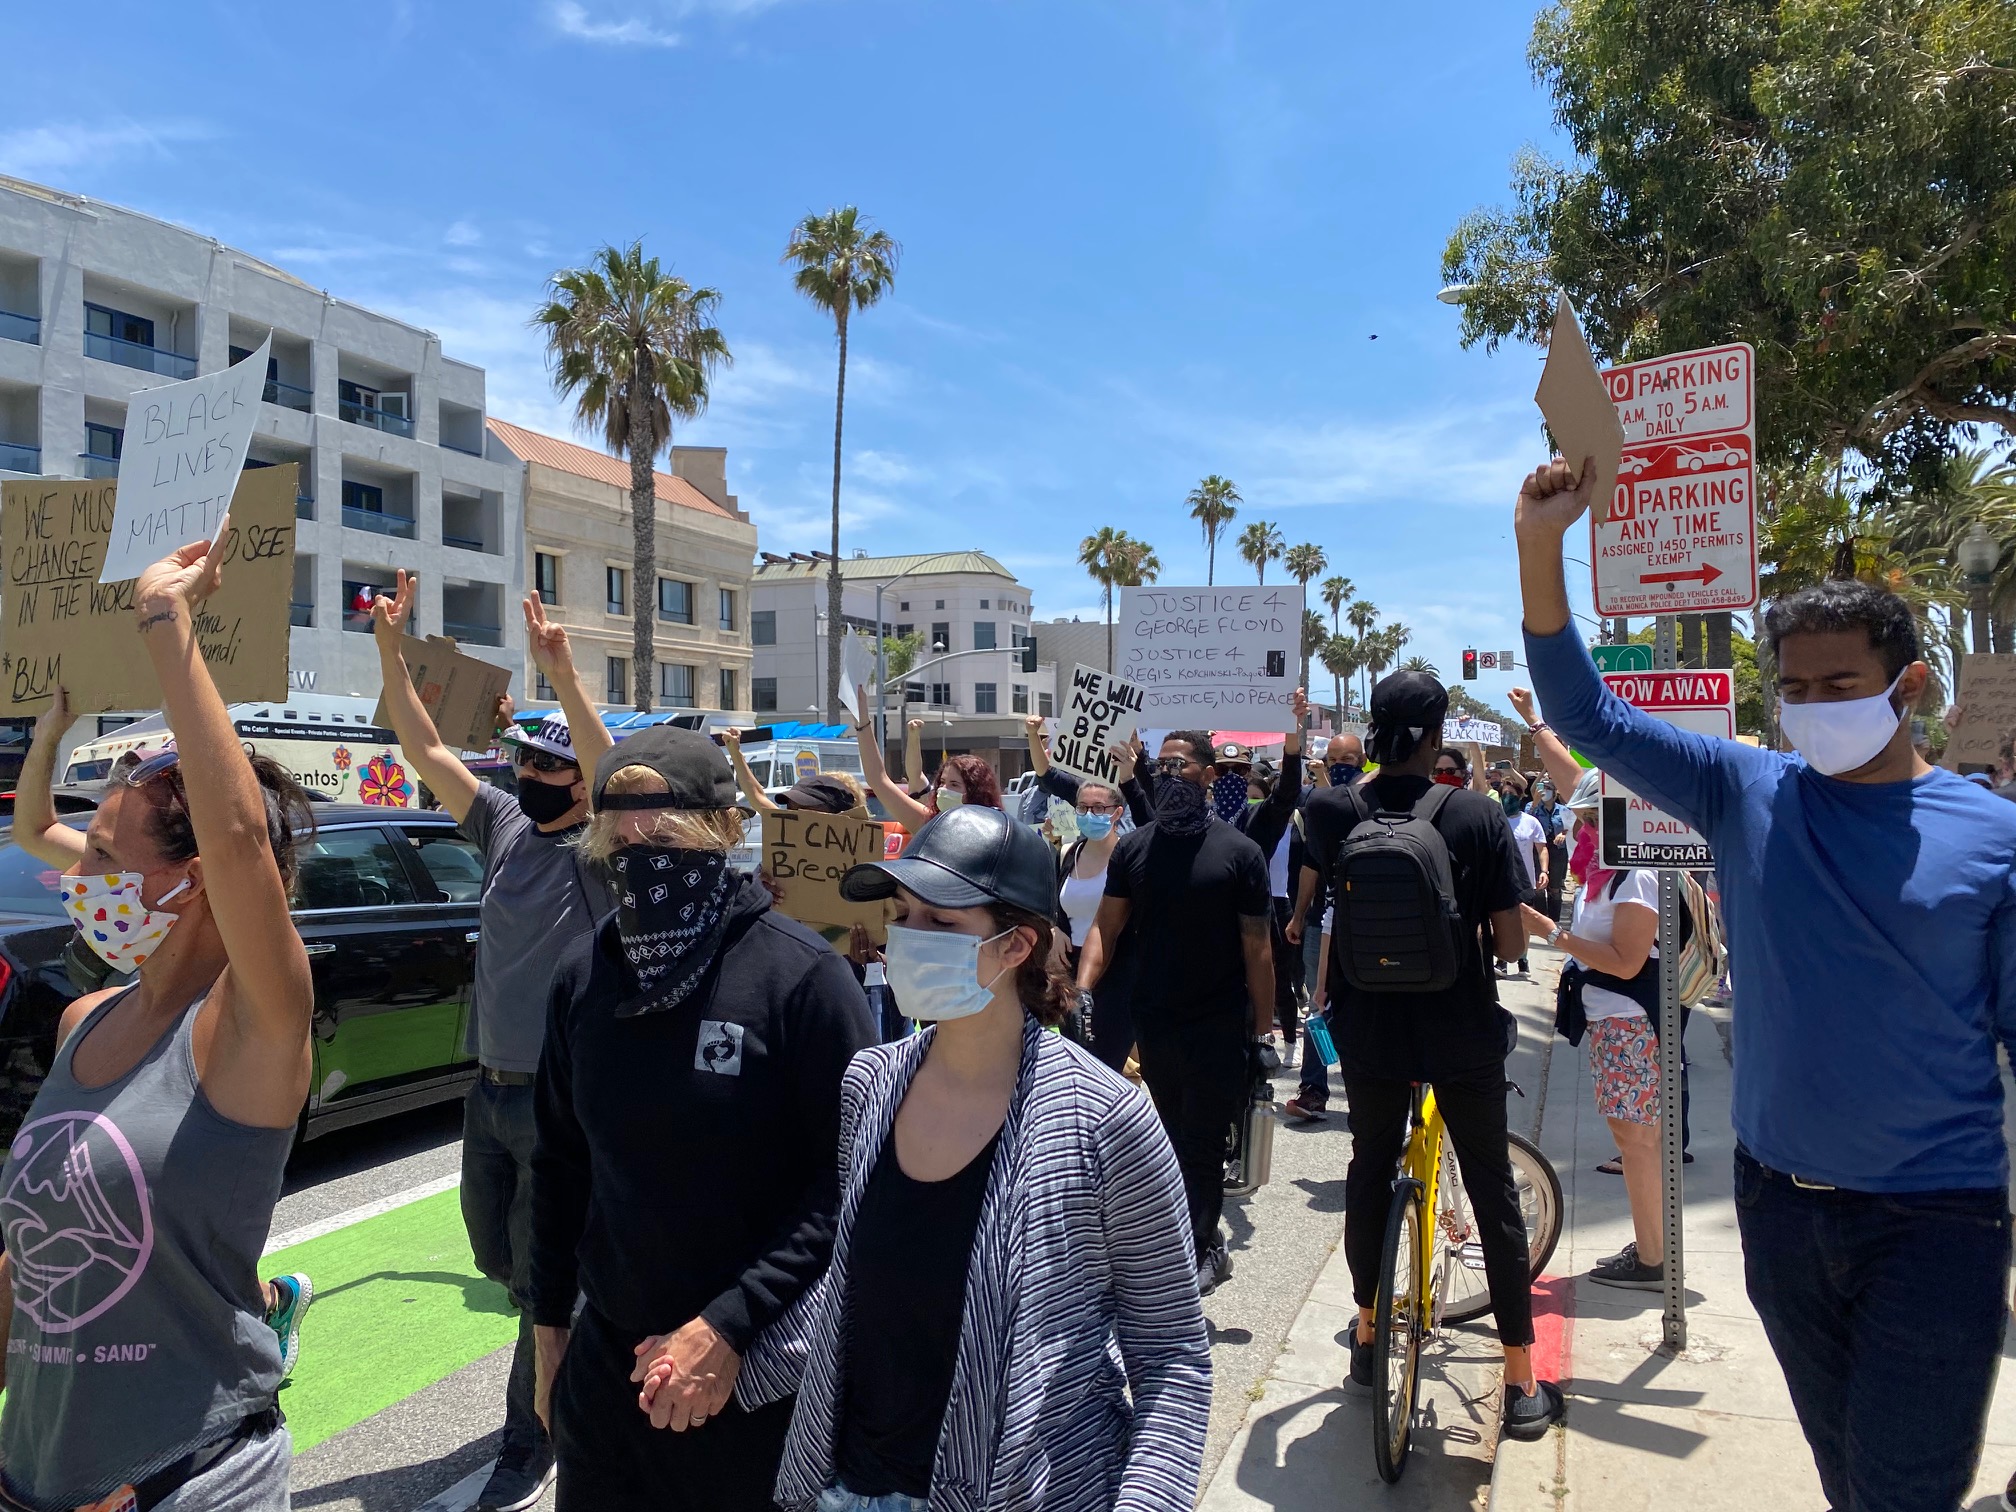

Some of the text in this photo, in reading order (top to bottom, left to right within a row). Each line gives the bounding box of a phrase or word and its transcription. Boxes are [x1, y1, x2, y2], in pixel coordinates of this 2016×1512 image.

[1638, 356, 1741, 396] PARKING
[143, 375, 244, 445] BLACK
[1623, 391, 1729, 425] A.M. TO 5 A.M.
[1646, 417, 1685, 437] DAILY
[153, 432, 234, 488] LIVES
[1606, 477, 1744, 518] O PARKING
[70, 487, 117, 535] MUS
[126, 494, 228, 554] MATTE
[1620, 511, 1721, 542] ANY TIME
[11, 541, 97, 584] CHANGE
[242, 525, 291, 562] SEE
[1601, 532, 1743, 558] ASSIGNED 1450 PERMITS
[1648, 551, 1692, 567] EXEMPT
[18, 580, 137, 627] IN THE WORL
[1137, 592, 1287, 616] JUSTICE 4
[1605, 604, 1624, 612] SANTA
[1625, 602, 1648, 610] MONICA
[1650, 600, 1673, 609] POLICE
[1674, 599, 1691, 607] DEPT
[1693, 598, 1710, 606] (310)
[1610, 587, 1738, 604] TO RECOVER IMPOUNDED VEHICLES CALL
[1135, 616, 1284, 639] GEORGE FLOYD
[1128, 646, 1245, 662] JUSTICE 4
[1123, 664, 1172, 683] REGIS
[1073, 669, 1144, 712] WE WILL
[1148, 689, 1297, 709] JUSTICE, NO PEACE
[1609, 678, 1721, 702] TOW AWAY
[1071, 692, 1127, 726] NOT
[1073, 716, 1110, 747] BE
[1442, 728, 1500, 743] BLACK LIVES
[1483, 723, 1498, 731] FOR
[293, 769, 338, 786] entos
[1629, 799, 1656, 811] AN
[770, 813, 882, 856] I CAN'T
[1643, 821, 1691, 834] DAILY
[1617, 845, 1714, 860] TEMPORAR
[772, 850, 857, 882] Breat
